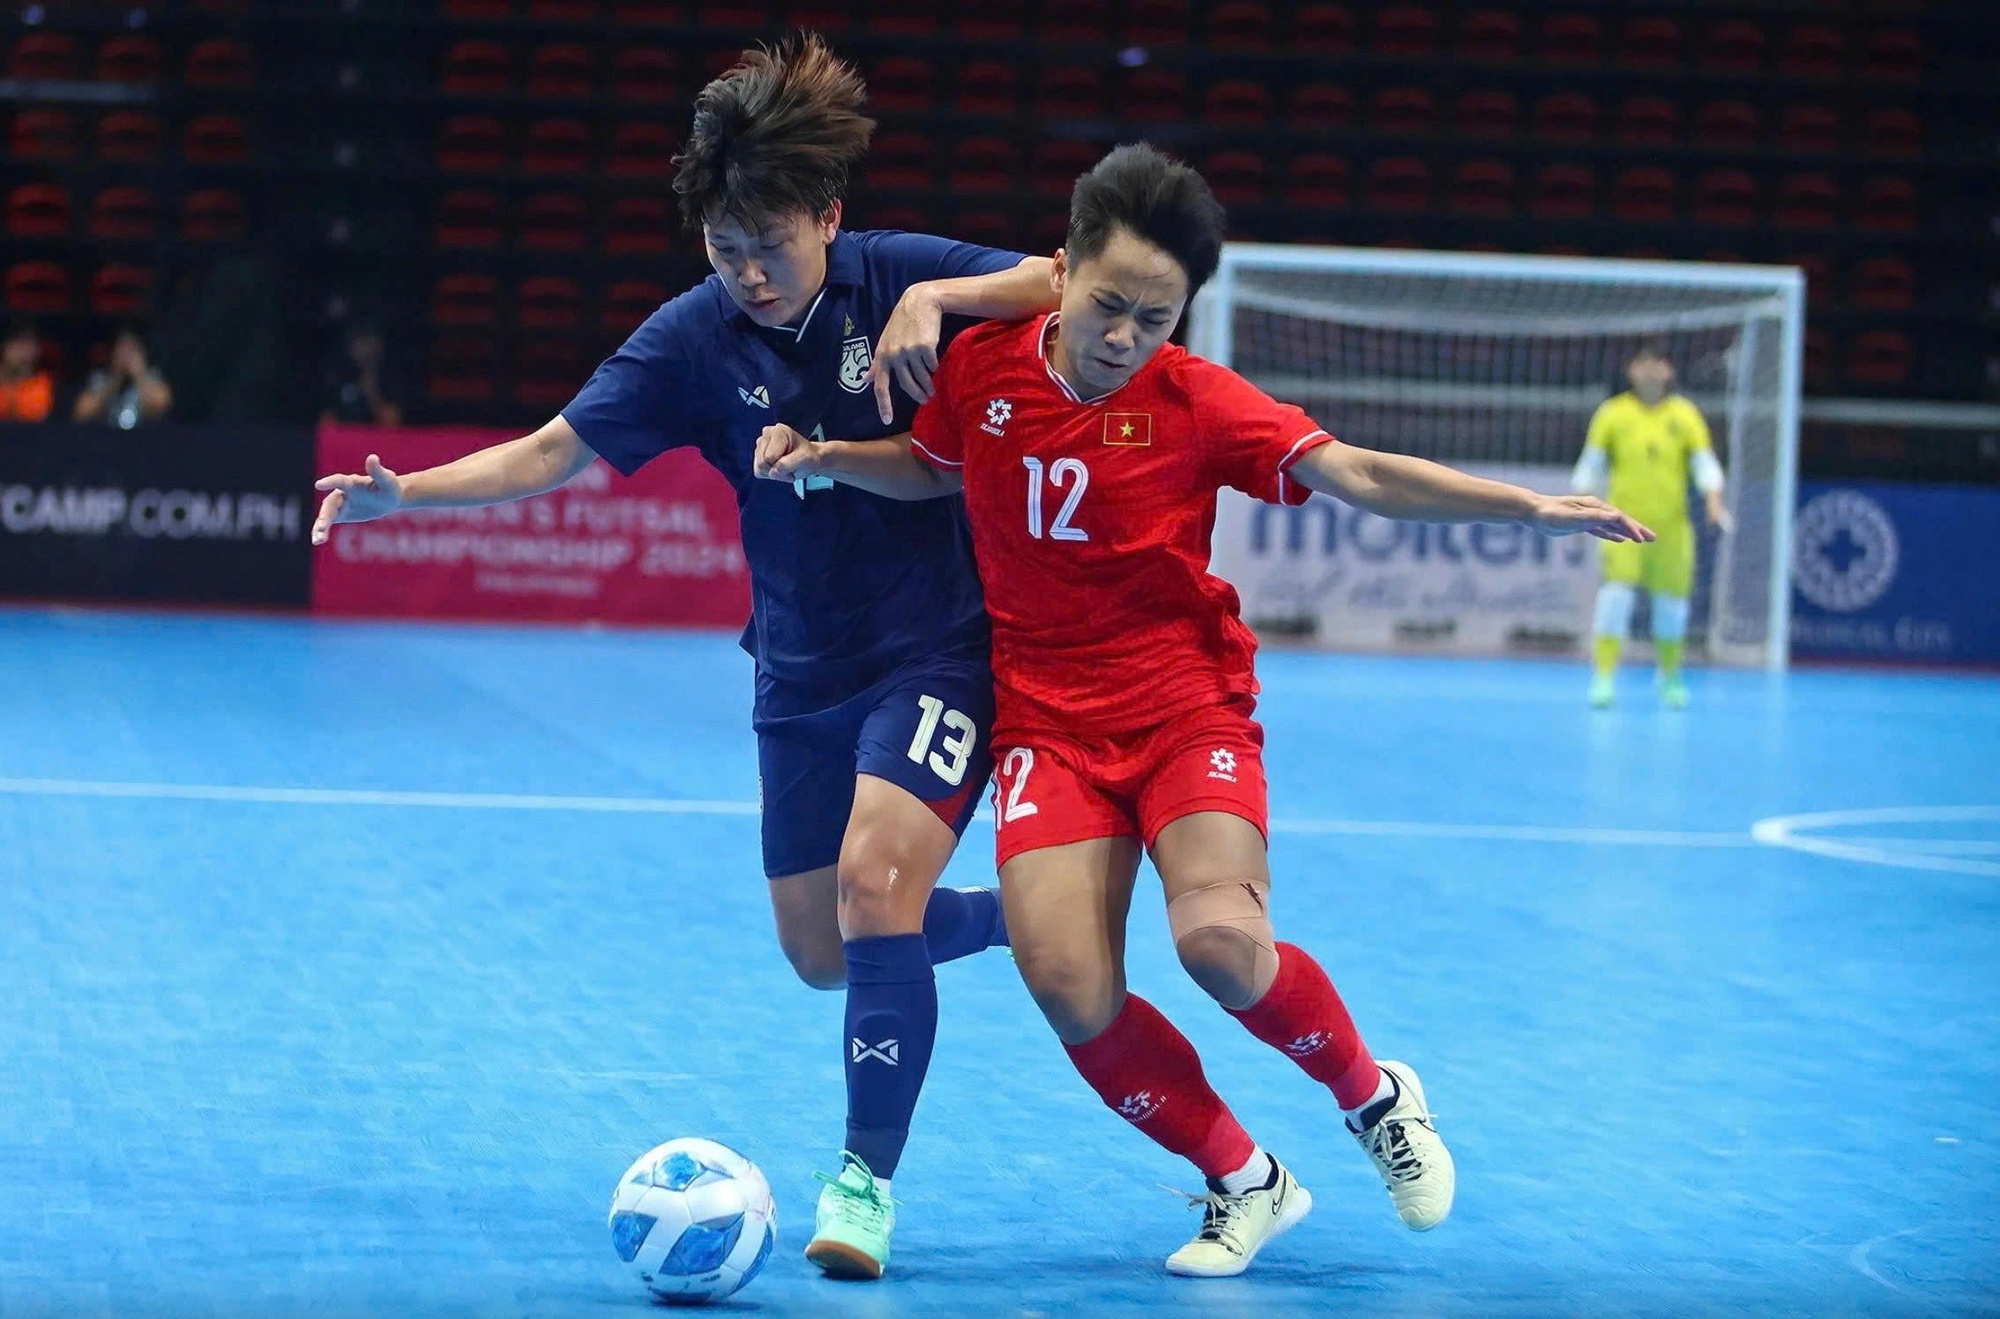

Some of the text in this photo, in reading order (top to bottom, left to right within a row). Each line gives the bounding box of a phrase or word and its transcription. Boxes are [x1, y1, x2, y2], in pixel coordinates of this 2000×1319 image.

[0, 484, 300, 542] CAMP.COM.PH
[1022, 456, 1089, 541] 12
[907, 693, 978, 787] 13
